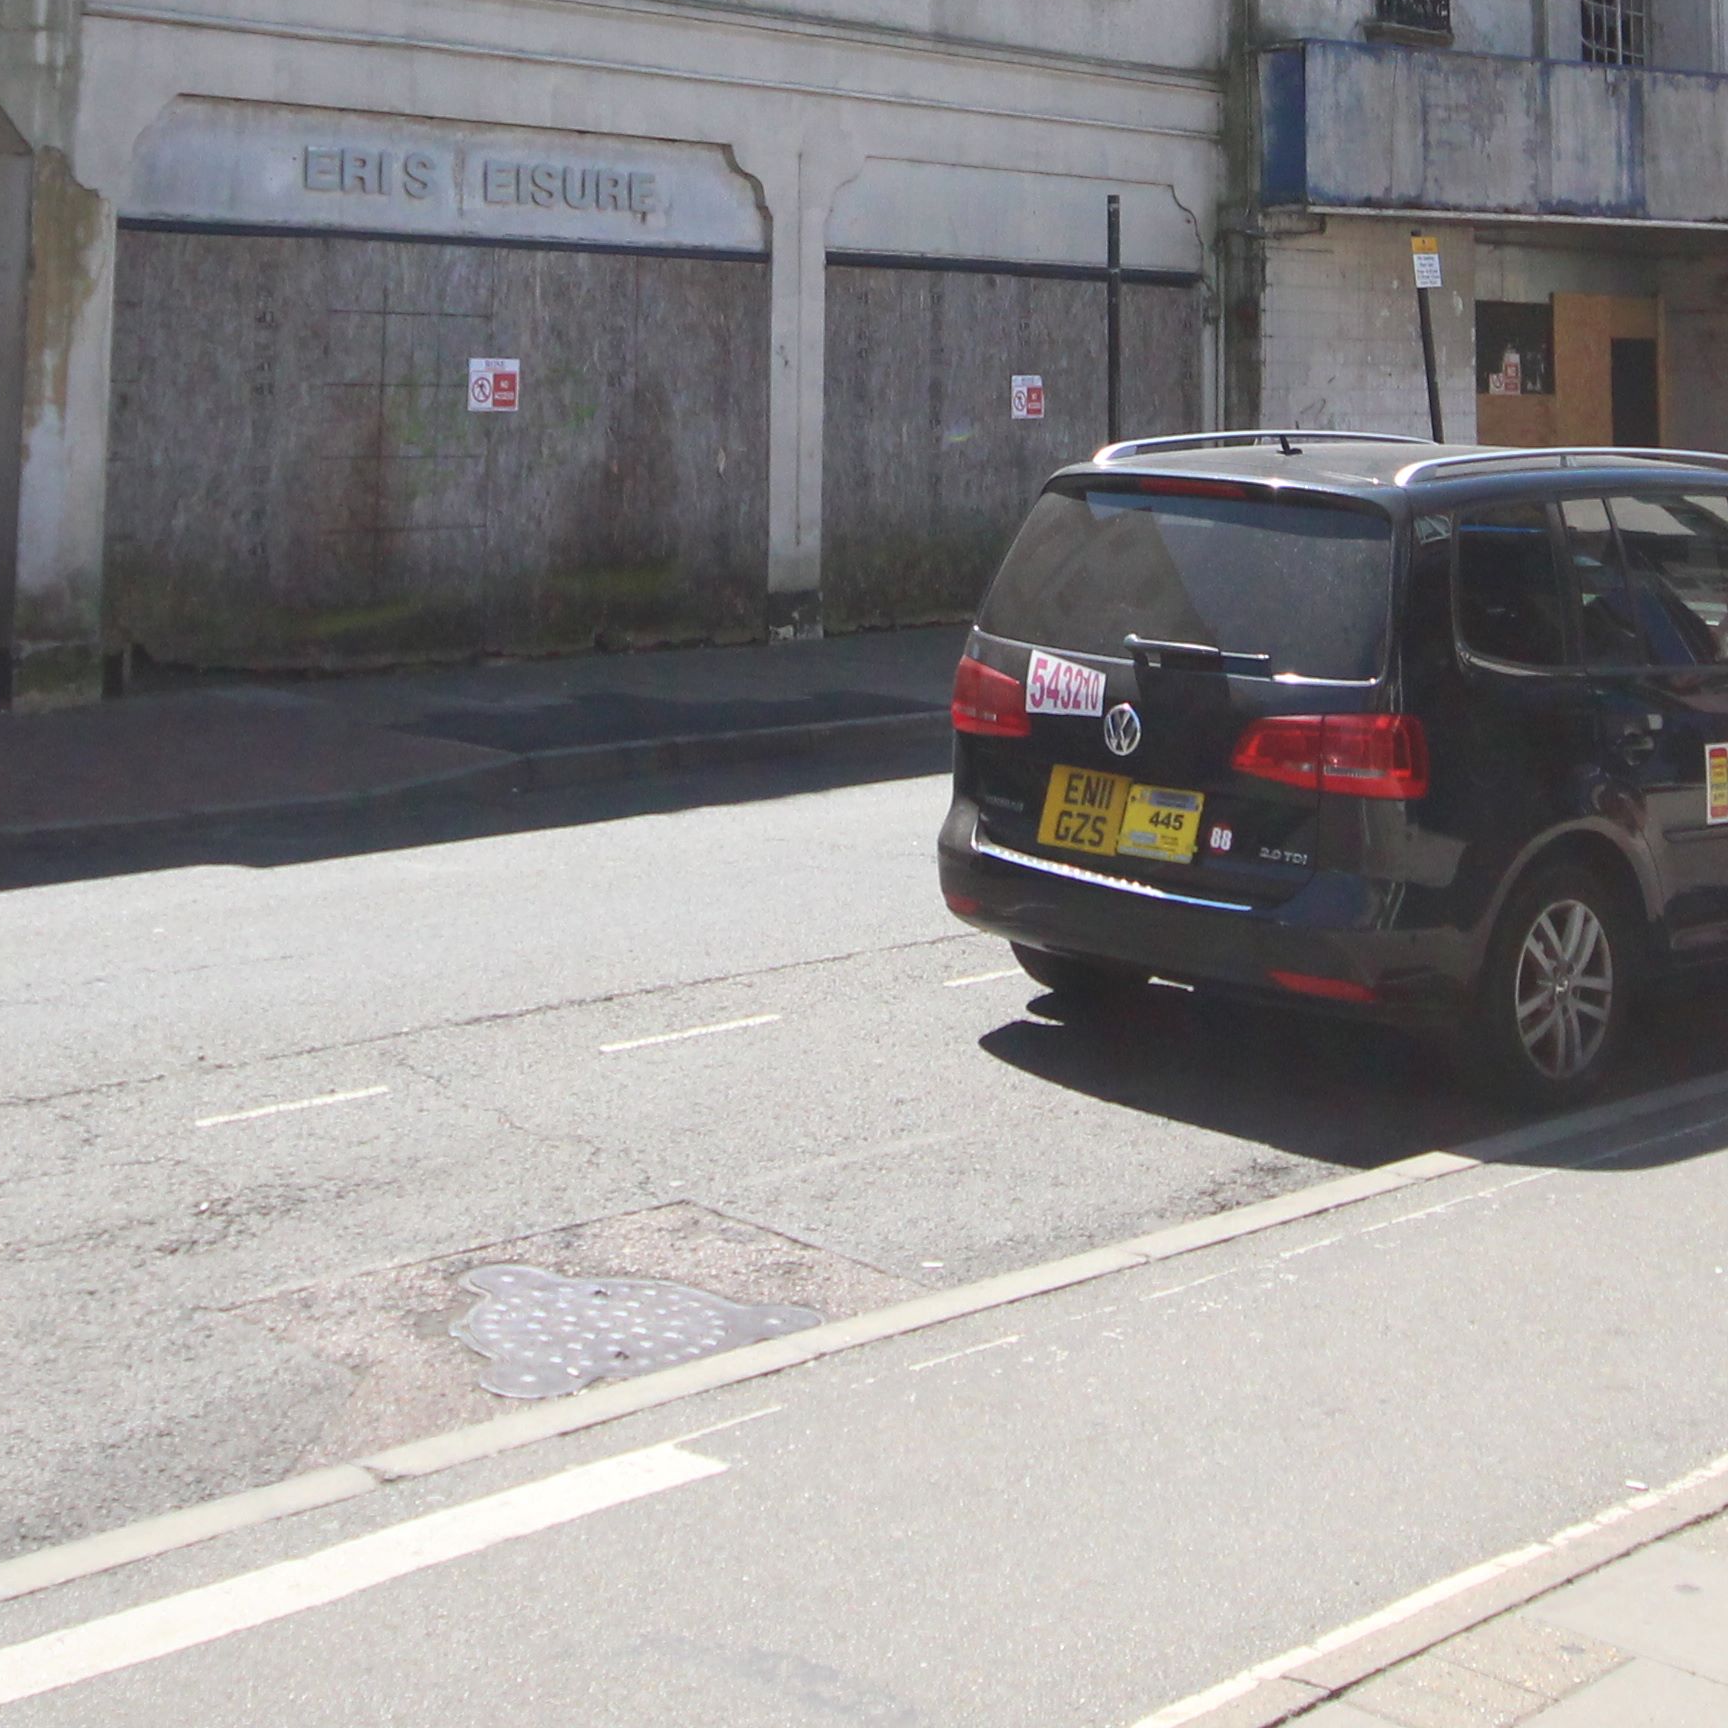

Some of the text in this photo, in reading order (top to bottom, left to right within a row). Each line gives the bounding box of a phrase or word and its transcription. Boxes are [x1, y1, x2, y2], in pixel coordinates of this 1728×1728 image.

[1030, 657, 1101, 711] 543210
[1055, 810, 1108, 848] GZS
[1149, 811, 1185, 831] 445
